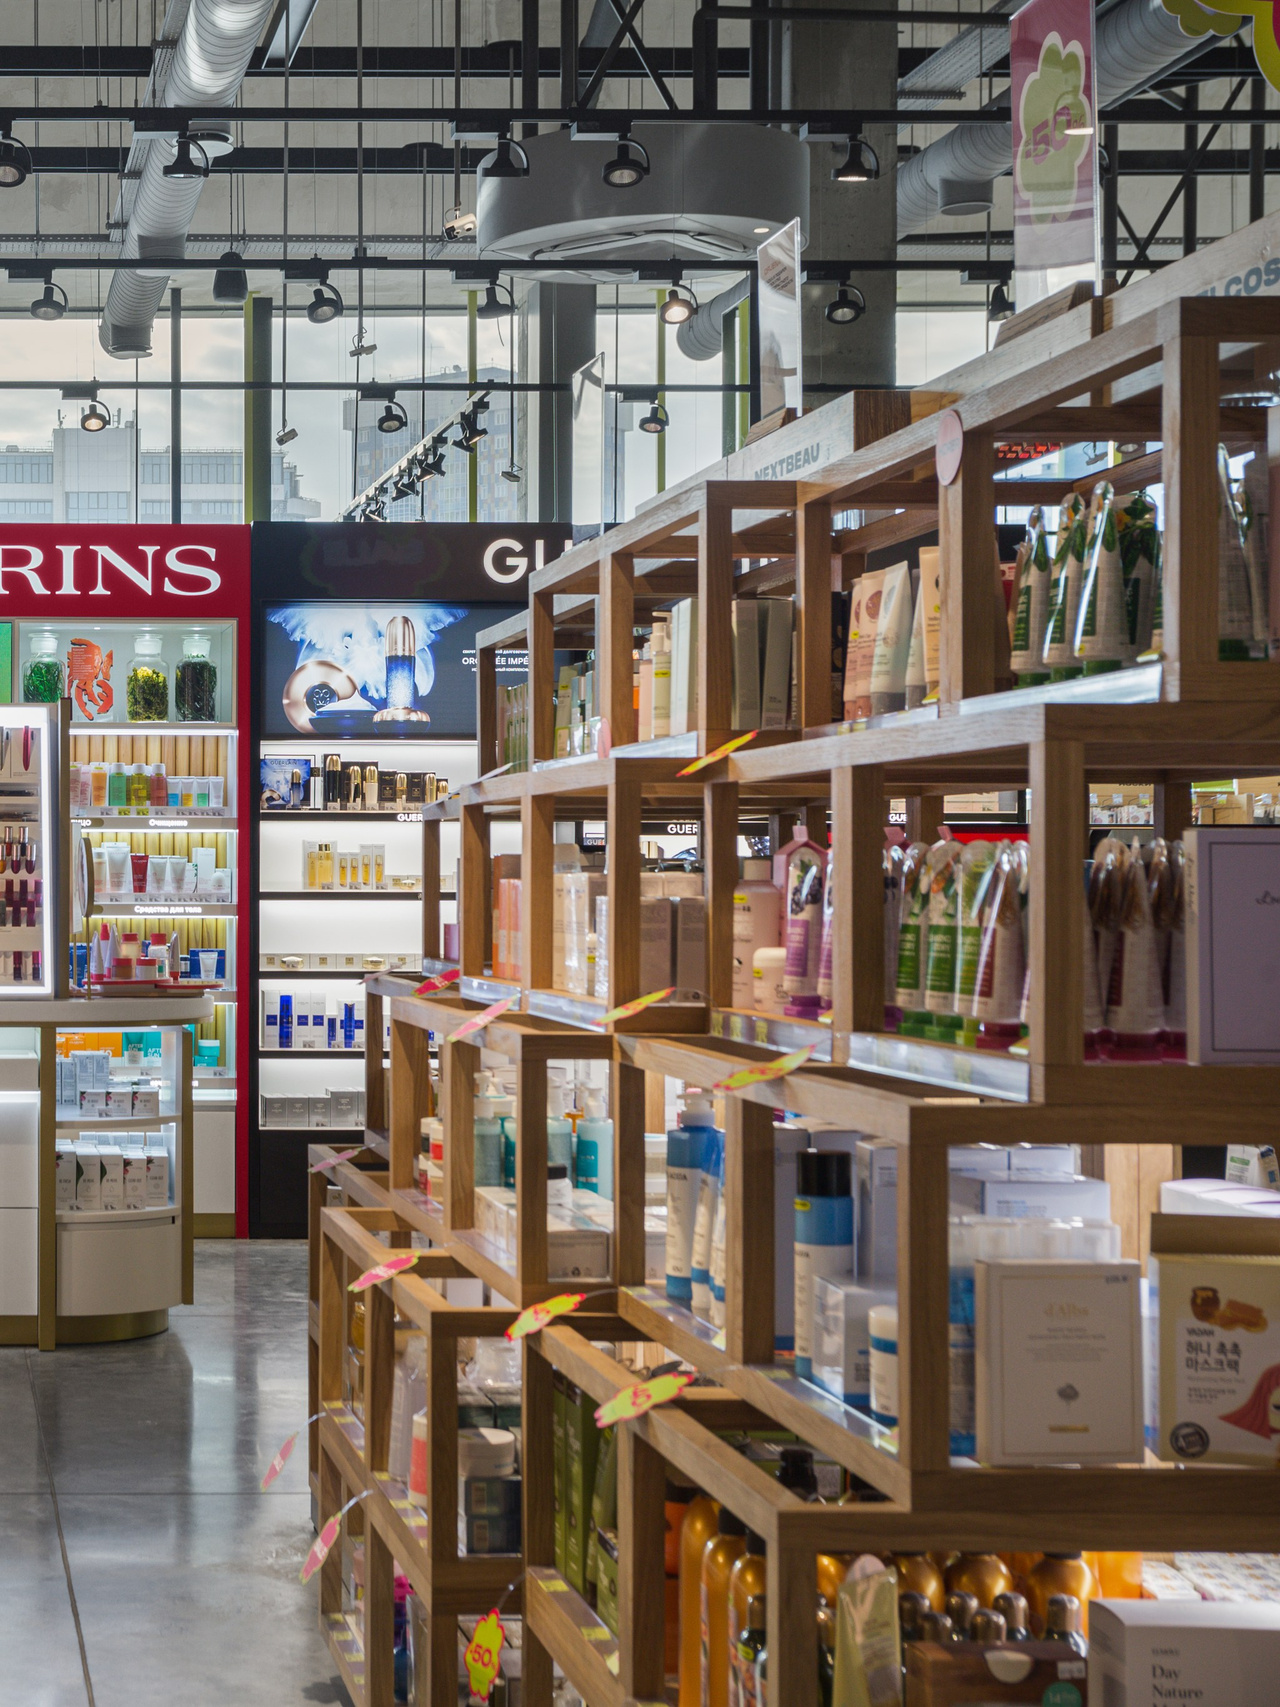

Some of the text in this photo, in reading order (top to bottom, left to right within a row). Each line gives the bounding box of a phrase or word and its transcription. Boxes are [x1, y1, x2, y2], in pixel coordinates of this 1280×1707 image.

[754, 442, 820, 480] NEXTBEAU
[397, 813, 423, 822] GUER
[134, 905, 169, 914] Средства
[169, 906, 184, 914] для
[1151, 1664, 1180, 1681] Day
[1151, 1683, 1204, 1700] Nature
